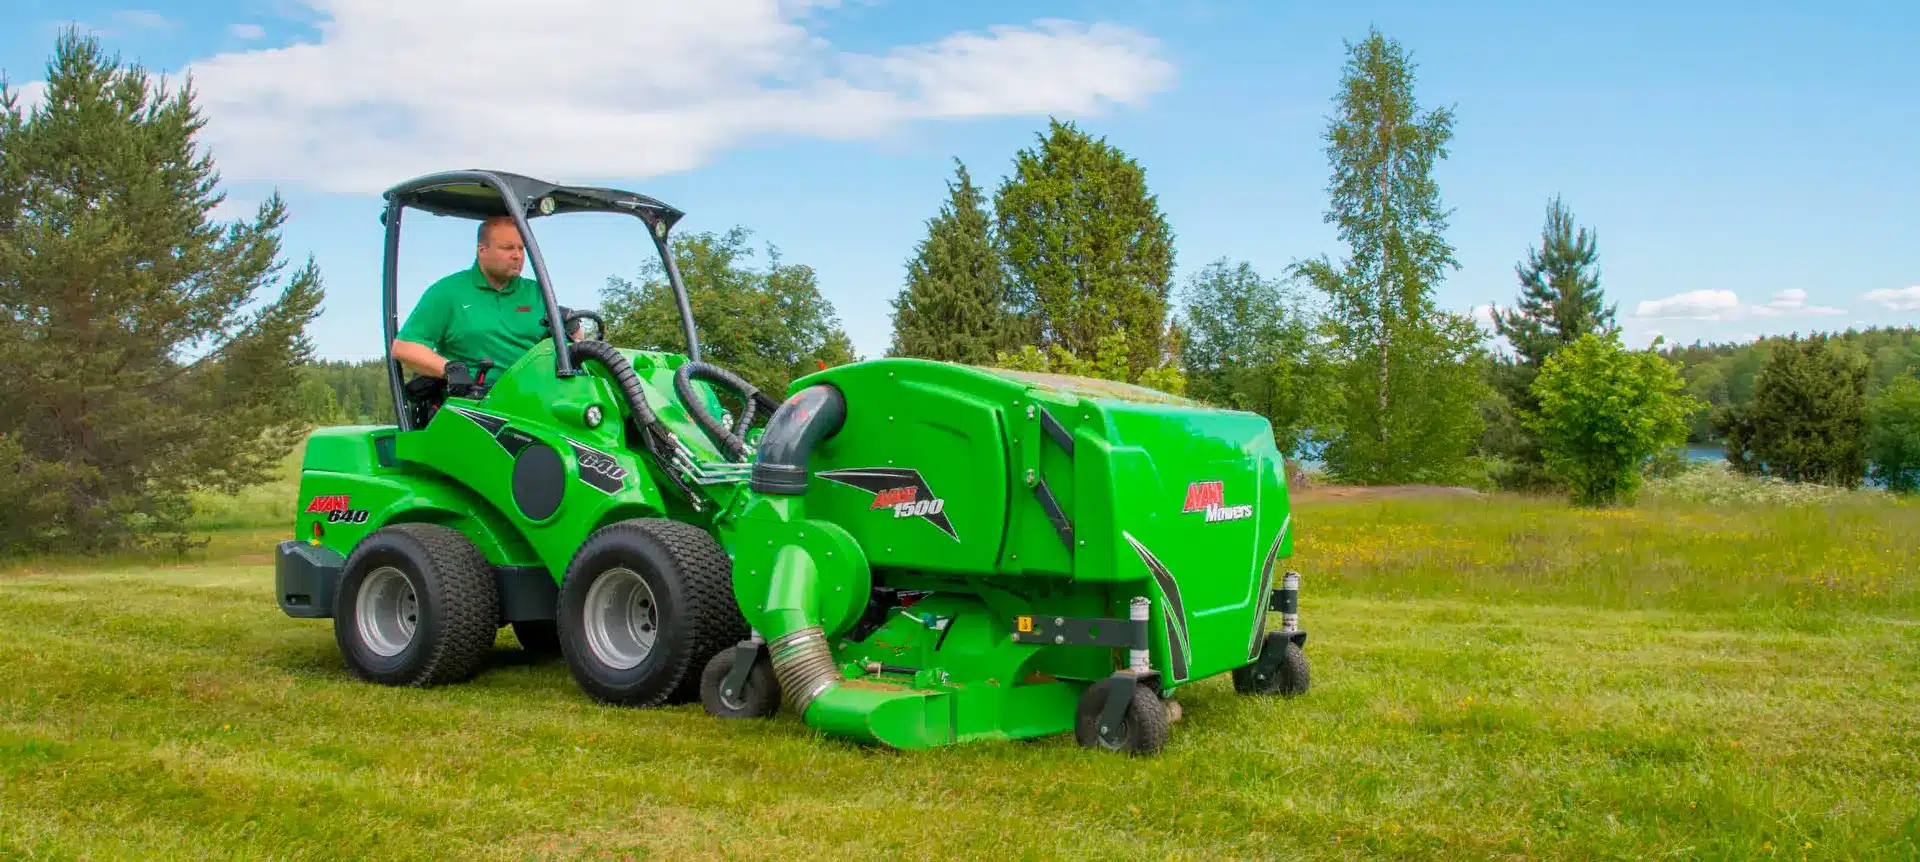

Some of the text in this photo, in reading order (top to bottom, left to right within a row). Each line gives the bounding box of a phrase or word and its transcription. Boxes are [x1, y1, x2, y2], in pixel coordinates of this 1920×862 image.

[578, 452, 629, 479] 640
[305, 495, 350, 513] AVANT
[870, 486, 918, 510] AVANT
[1182, 481, 1224, 512] AVANT
[328, 509, 370, 524] 640
[893, 499, 944, 518] 1500
[1205, 503, 1252, 522] Mowers
